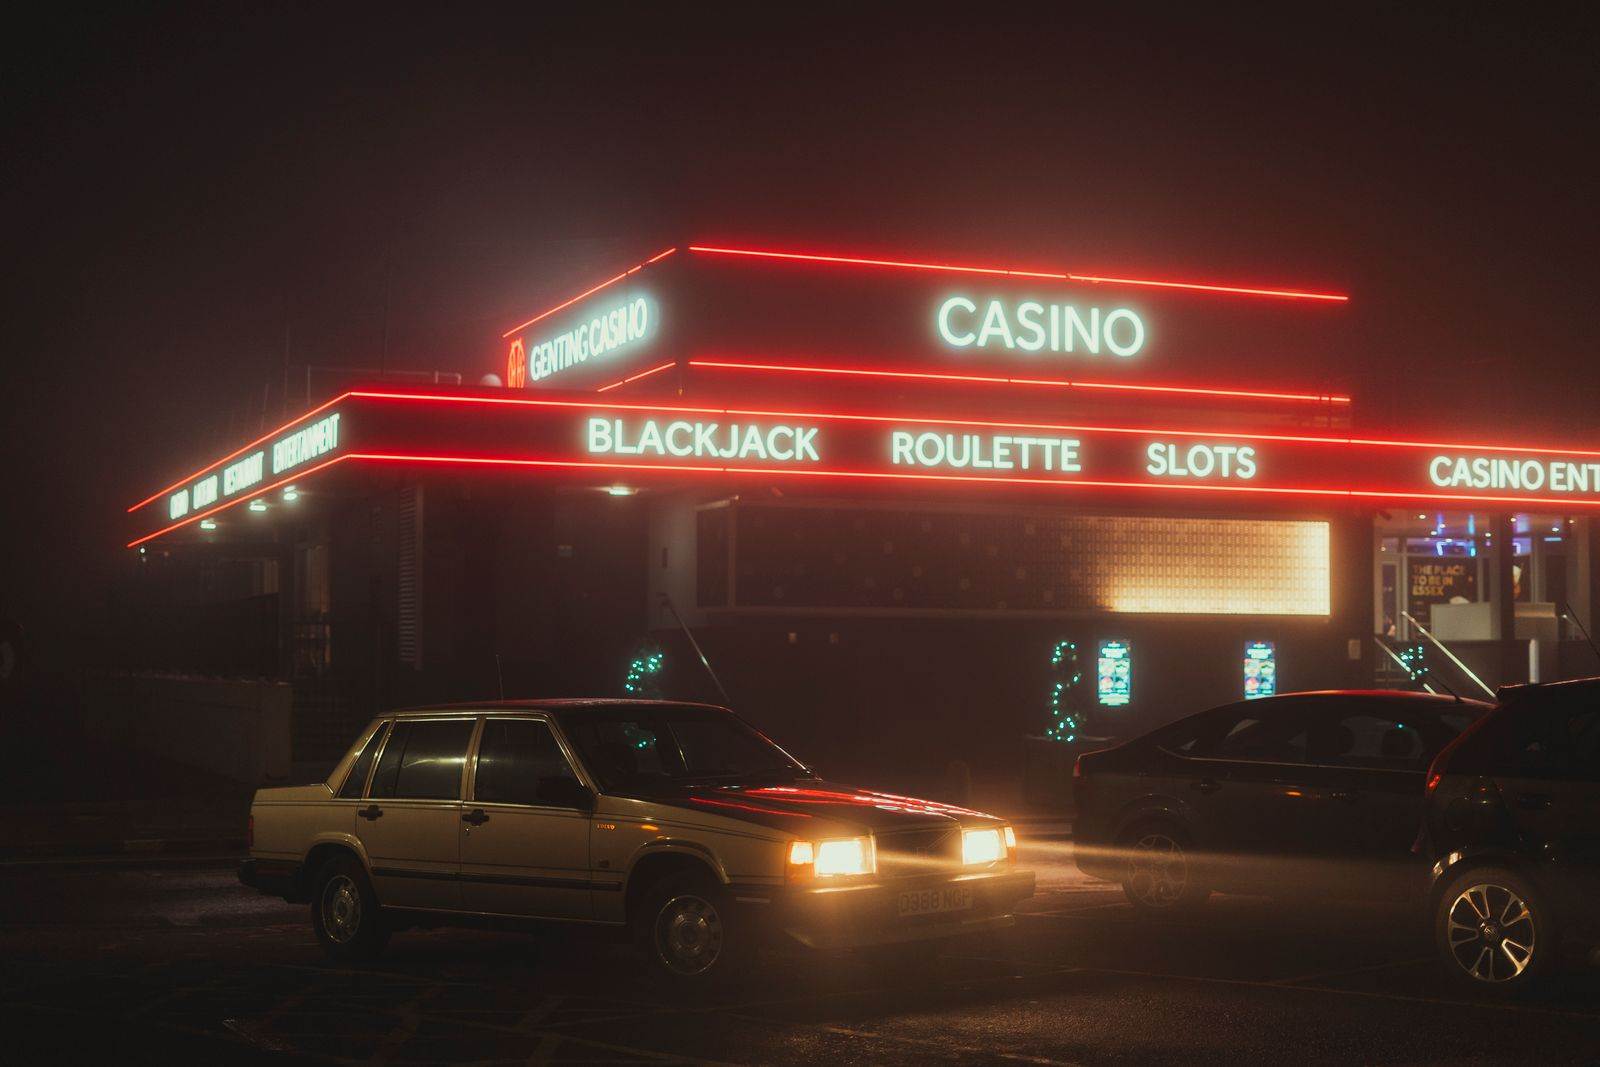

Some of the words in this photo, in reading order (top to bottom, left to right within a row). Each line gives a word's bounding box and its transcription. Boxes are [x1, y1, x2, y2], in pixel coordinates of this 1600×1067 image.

[529, 324, 590, 382] GENTING
[588, 297, 649, 357] CASINO
[936, 295, 1147, 358] CASINO
[586, 417, 822, 463] BLACKJACK
[891, 431, 1082, 474] ROULETTE
[1146, 441, 1257, 480] SLOTS
[1429, 455, 1545, 491] CASINO
[1412, 575, 1427, 585] TO
[1412, 585, 1444, 596] ESSEX
